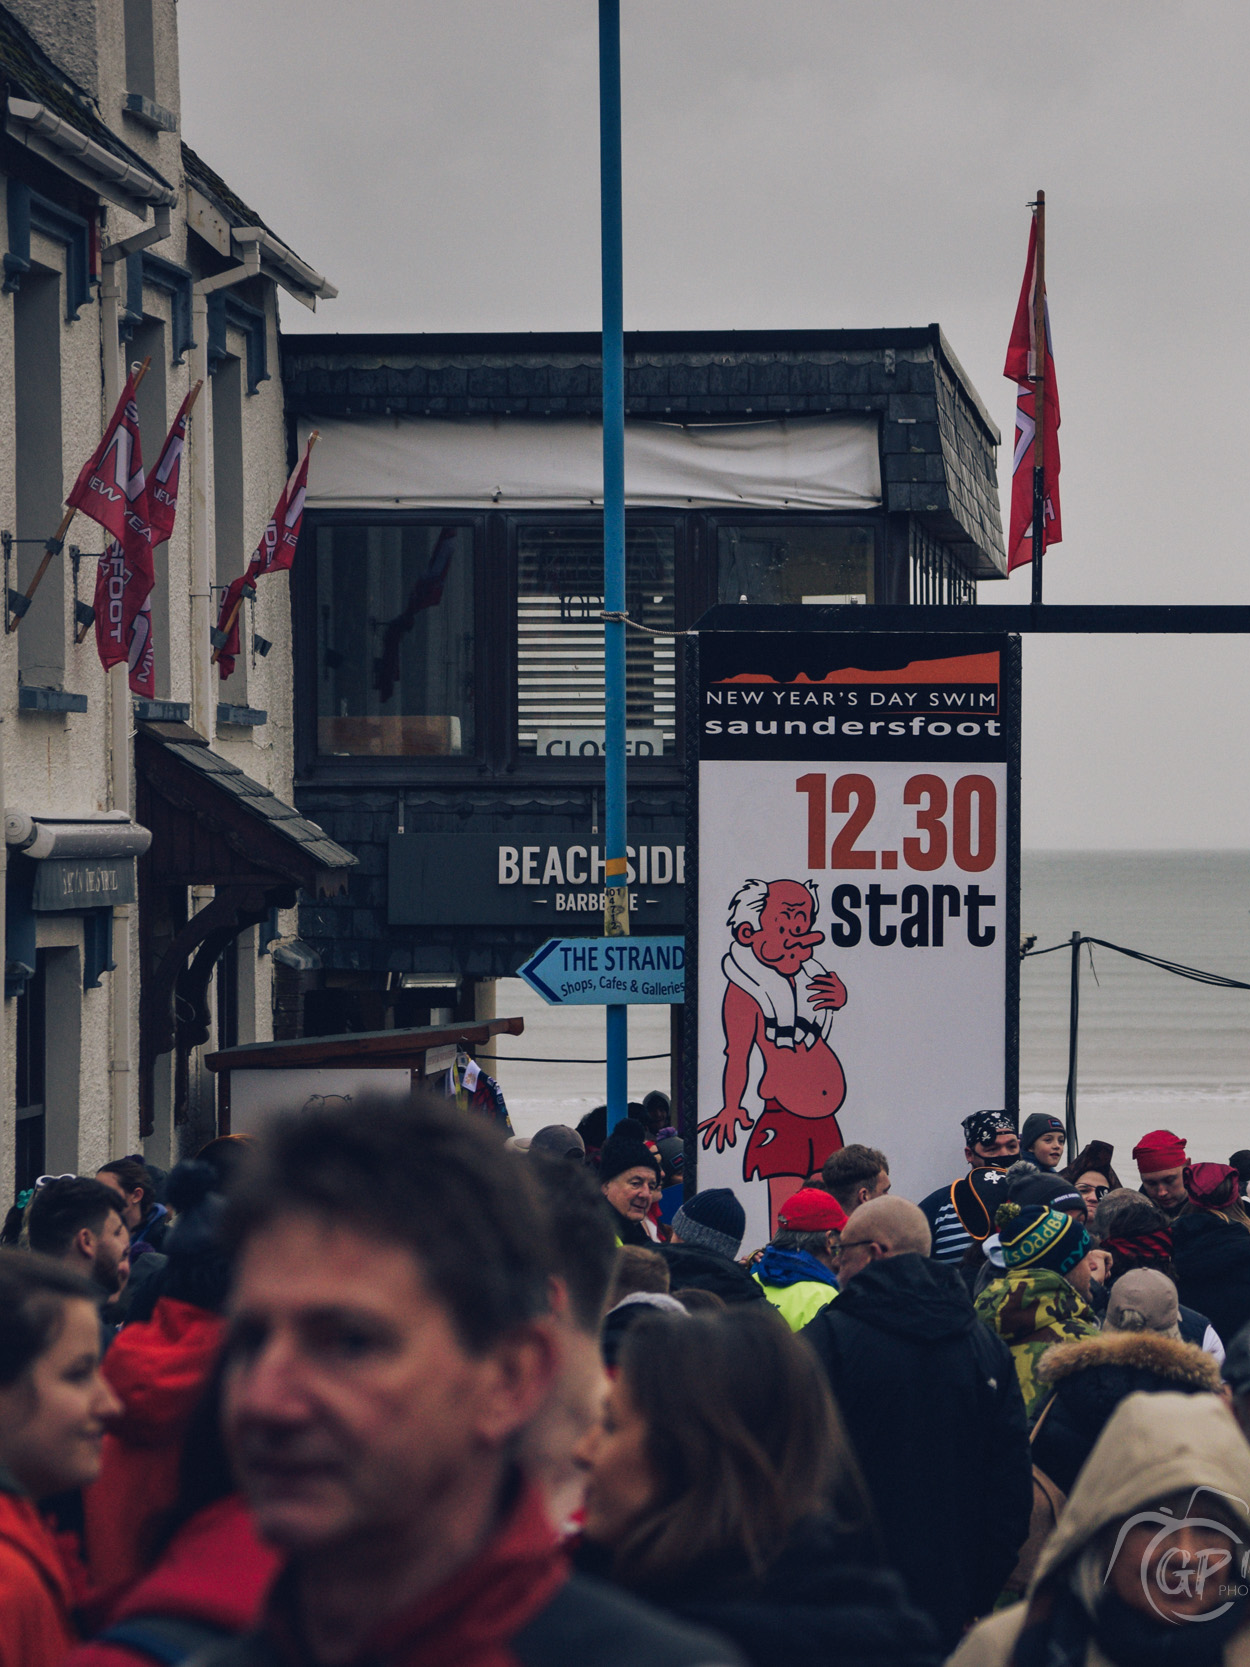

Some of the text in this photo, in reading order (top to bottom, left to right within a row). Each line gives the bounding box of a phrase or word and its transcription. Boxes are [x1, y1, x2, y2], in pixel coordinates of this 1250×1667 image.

[706, 690, 996, 708] NEW YEAR'S DAY SWIM
[704, 716, 1001, 736] saundersfoot
[796, 773, 997, 872] 12.30
[830, 883, 996, 949] start
[560, 945, 685, 972] THE STRAND
[561, 976, 685, 997] Shops, Cafes & Galleries
